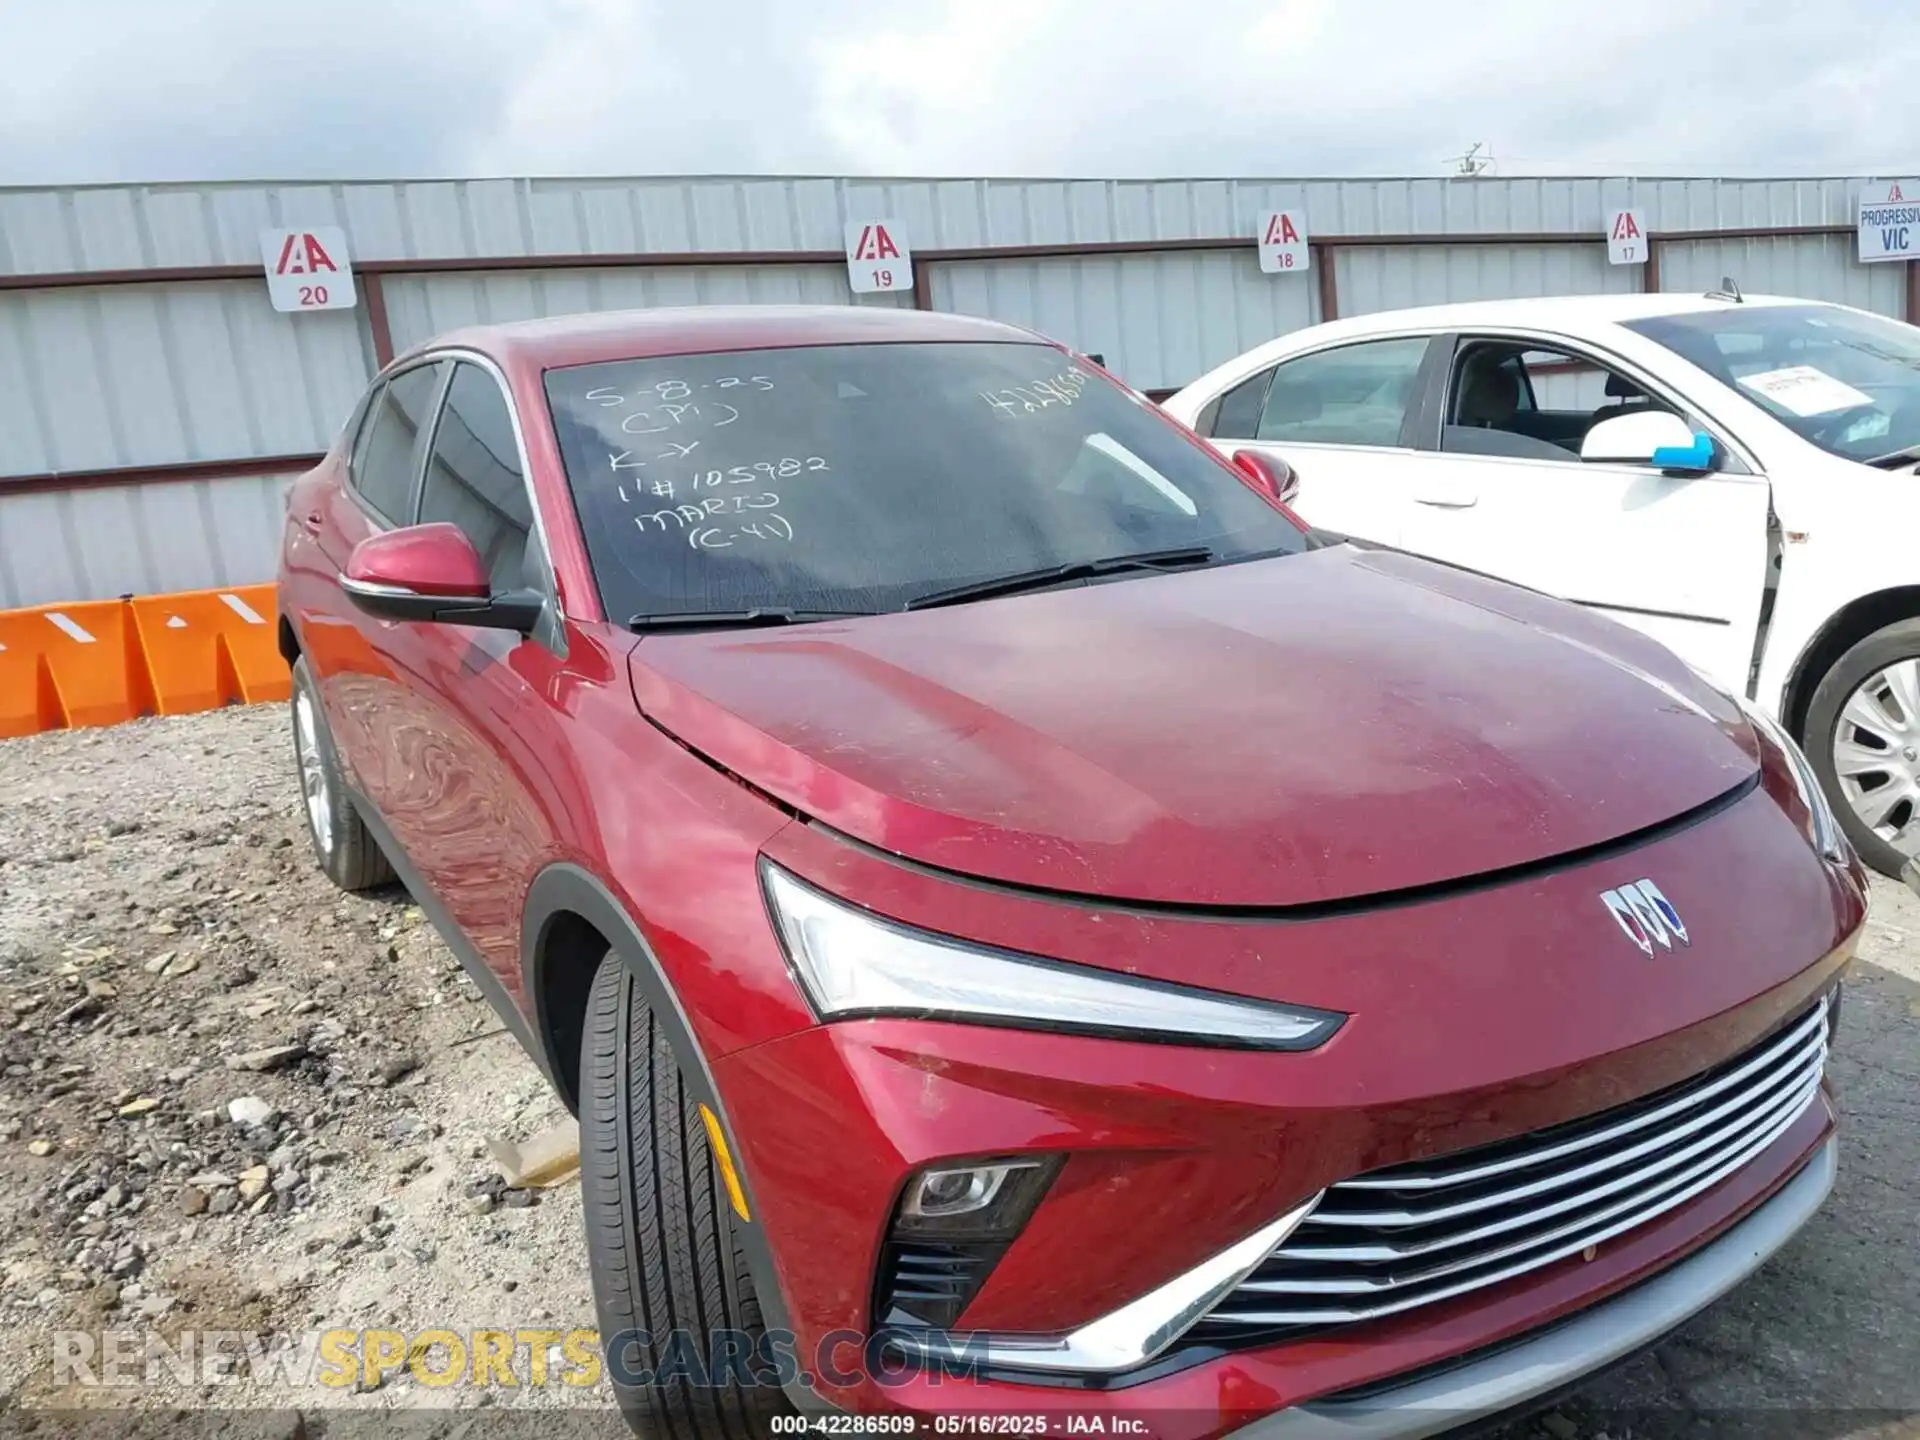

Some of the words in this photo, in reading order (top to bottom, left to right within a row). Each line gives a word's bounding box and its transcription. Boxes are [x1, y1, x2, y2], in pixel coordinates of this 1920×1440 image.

[1882, 226, 1910, 251] VIC
[1277, 252, 1294, 268] 18
[1622, 246, 1635, 261] 17
[872, 270, 893, 288] 19
[299, 286, 328, 305] 20
